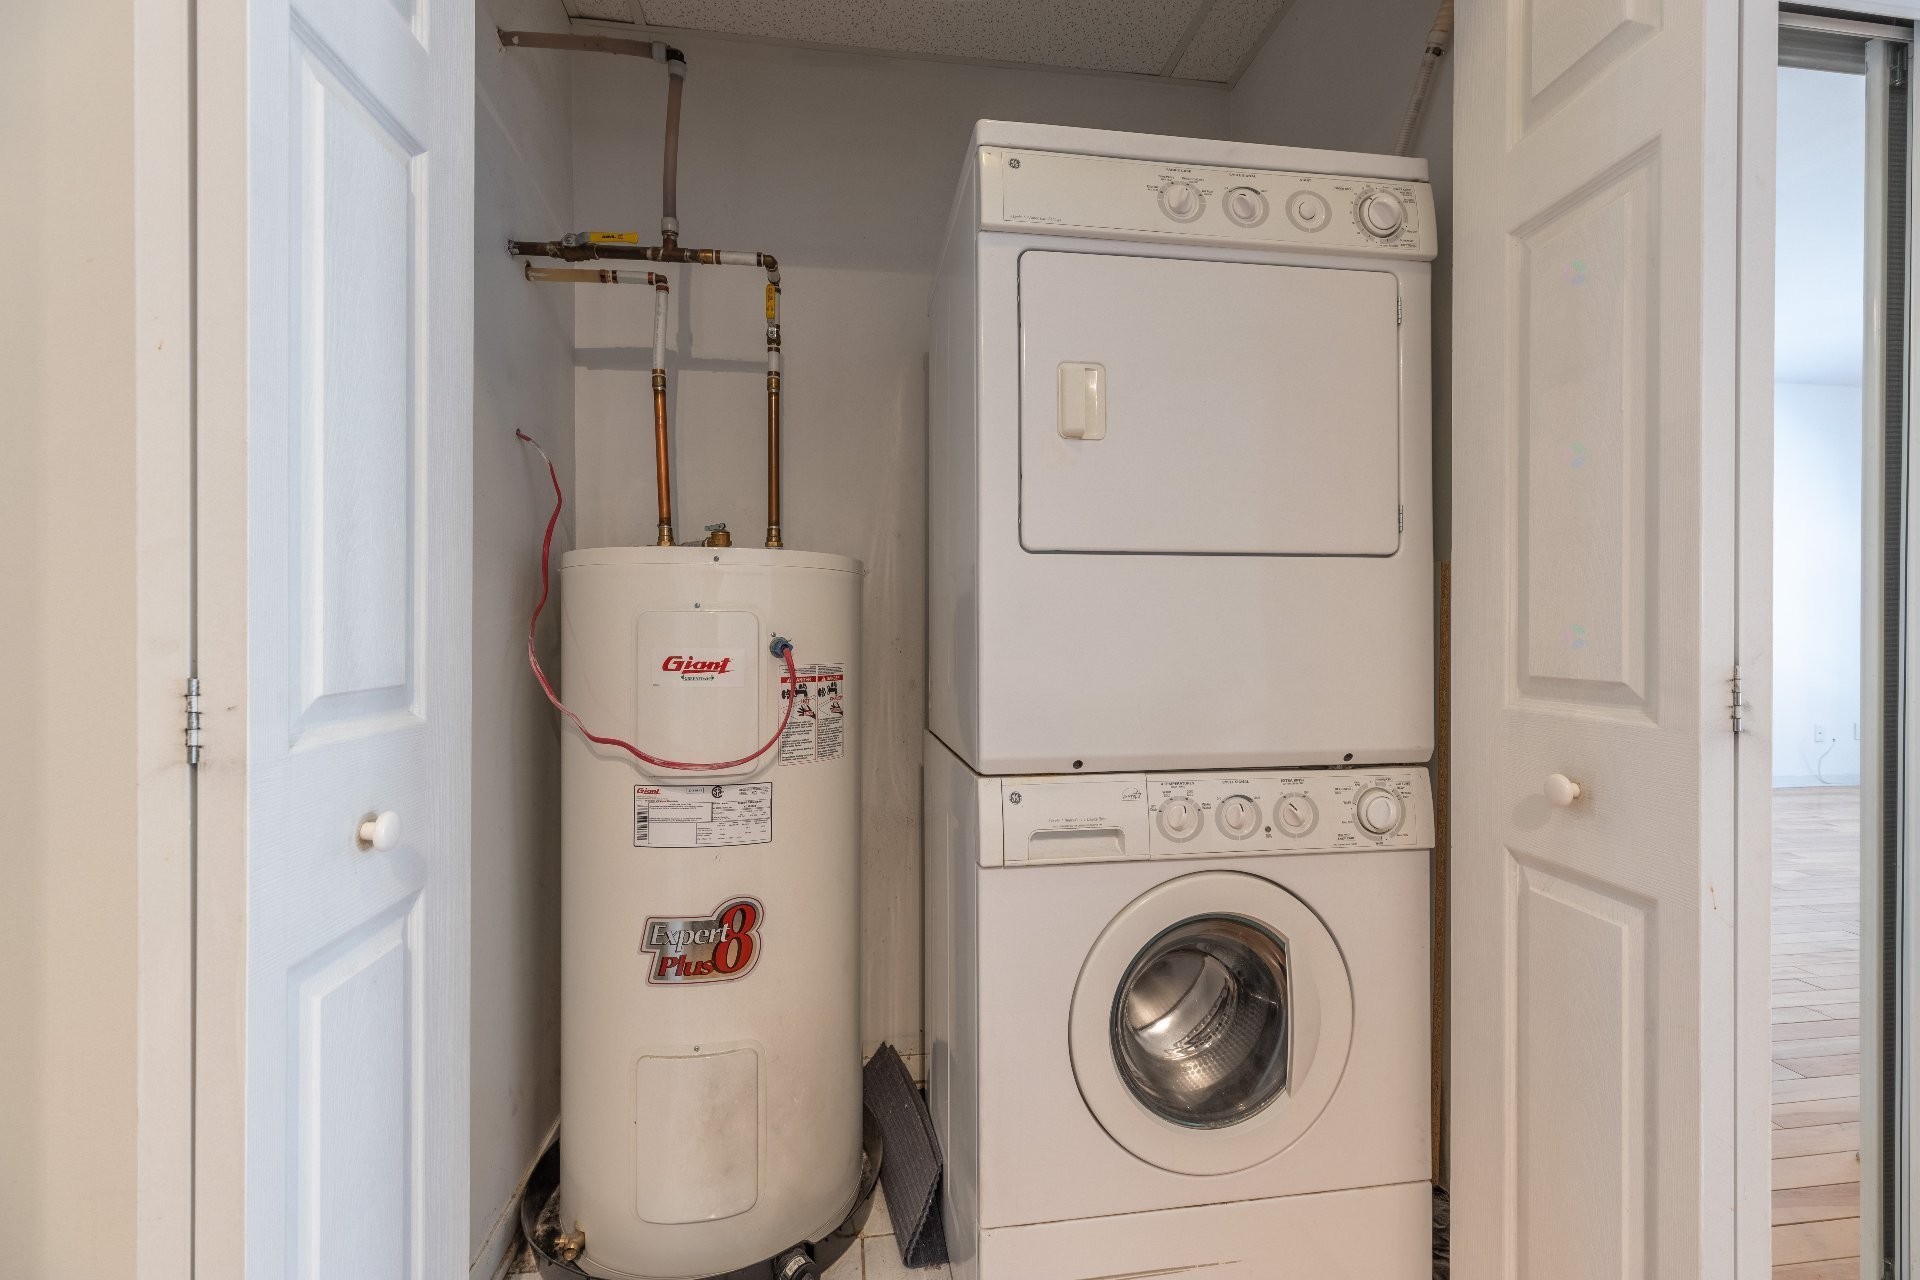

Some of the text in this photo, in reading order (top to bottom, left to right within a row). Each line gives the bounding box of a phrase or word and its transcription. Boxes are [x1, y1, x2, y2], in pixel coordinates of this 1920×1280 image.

[661, 655, 733, 675] Giant
[636, 787, 661, 795] Giant
[650, 922, 731, 953] Expert
[712, 902, 756, 974] 8
[657, 953, 715, 977] Plus
